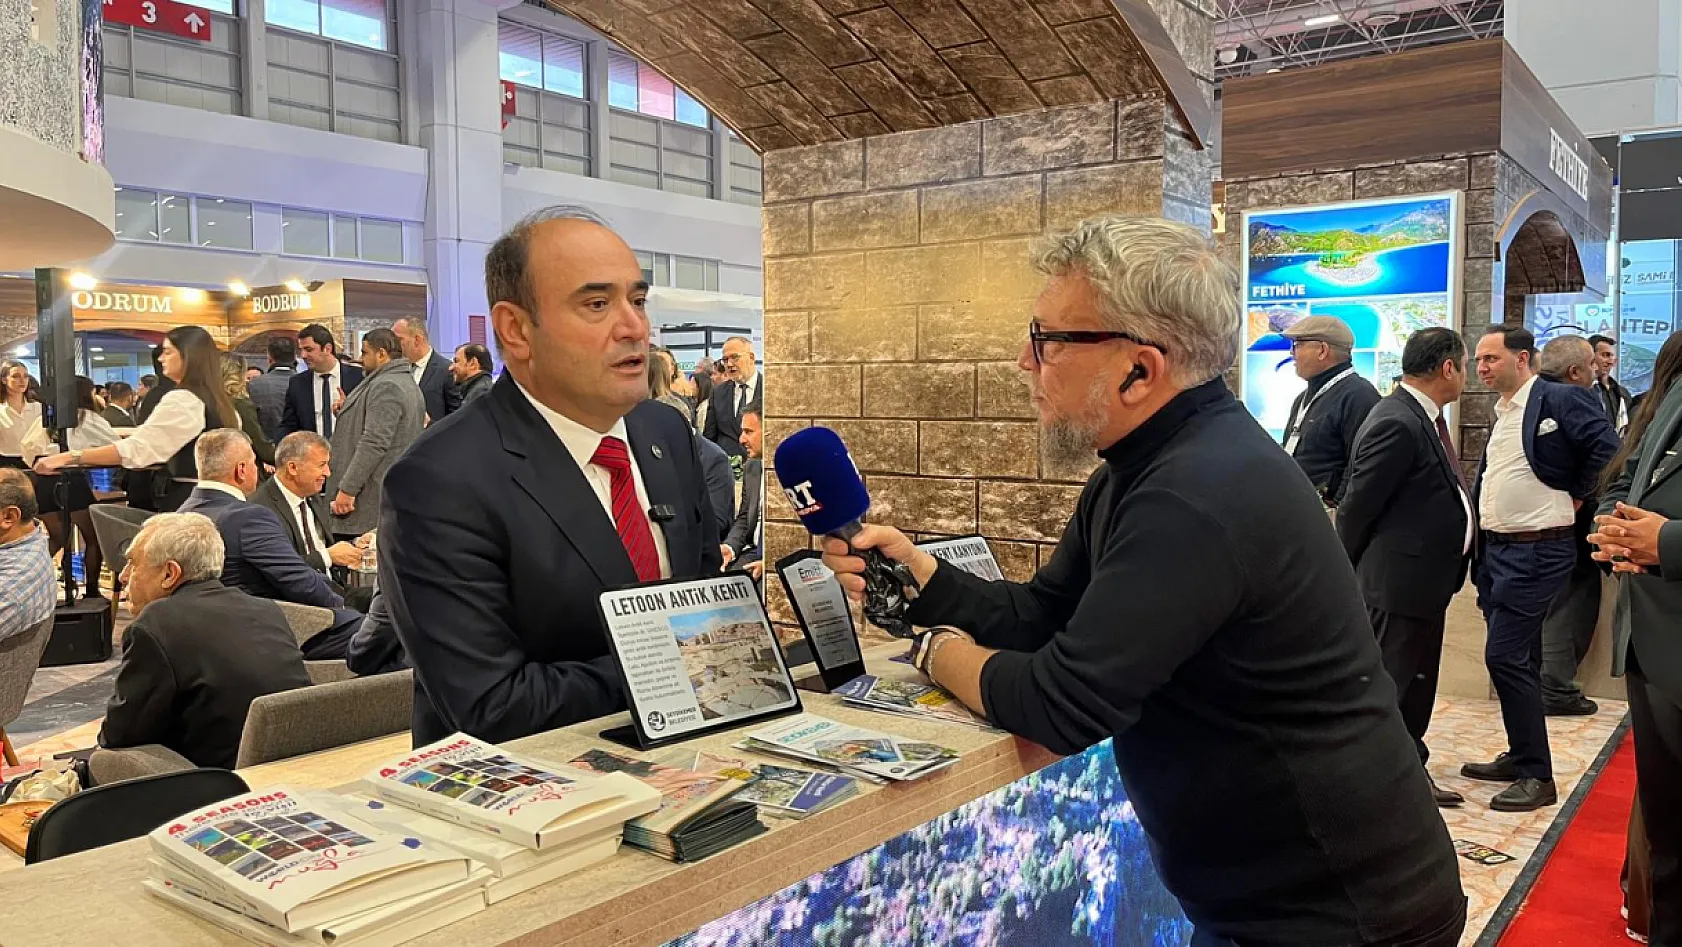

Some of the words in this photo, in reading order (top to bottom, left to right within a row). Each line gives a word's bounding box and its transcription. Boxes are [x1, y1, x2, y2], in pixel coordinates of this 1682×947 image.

[142, 1, 156, 23] 3
[1252, 281, 1306, 298] FETHİYE
[72, 290, 173, 313] ODRUM
[253, 293, 312, 314] BODRUM
[610, 592, 667, 617] LETOON
[398, 739, 471, 767] SEASONS
[191, 790, 287, 824] SEASONS
